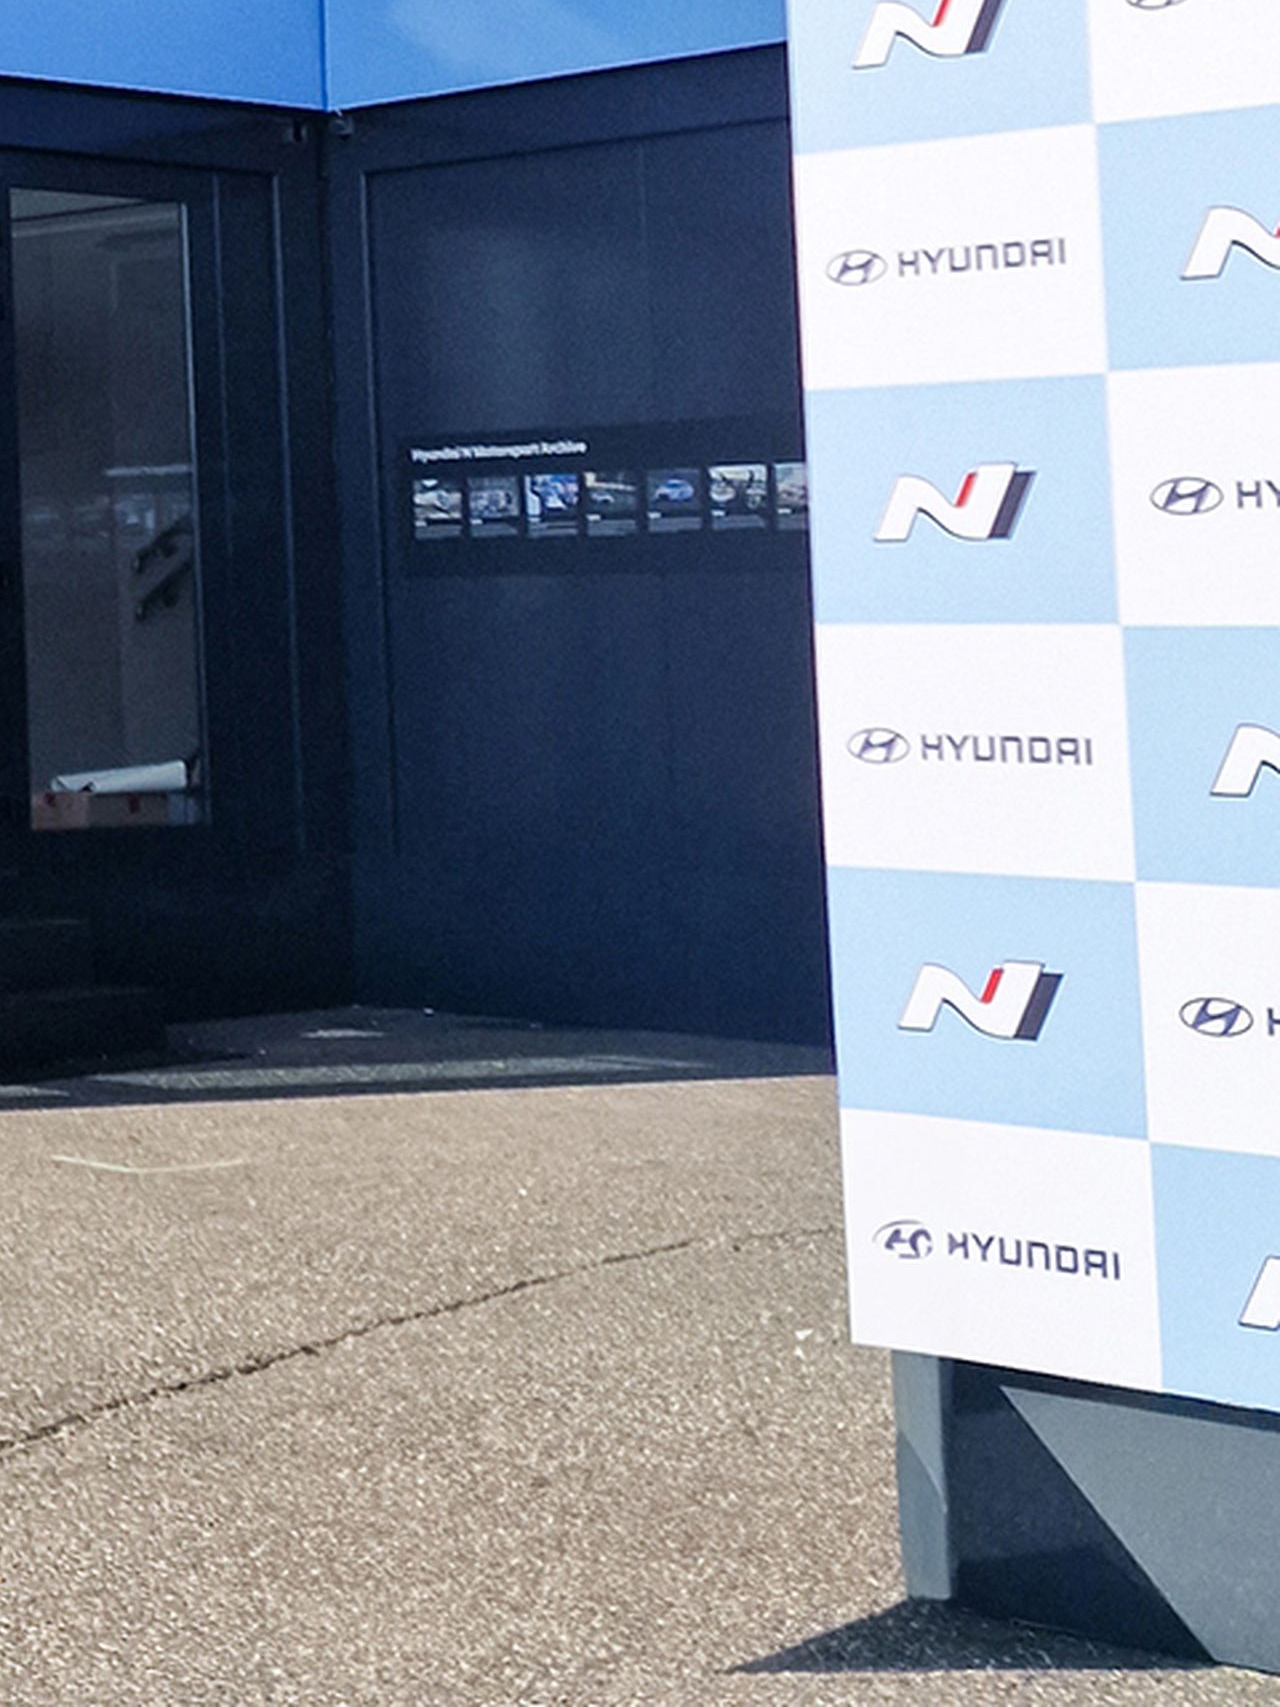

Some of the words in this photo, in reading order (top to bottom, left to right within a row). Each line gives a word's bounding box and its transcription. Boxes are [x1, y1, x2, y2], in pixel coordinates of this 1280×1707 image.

[896, 237, 1067, 278] HYUNDAI
[919, 734, 1093, 766] HYUNDAI
[947, 1231, 1122, 1281] HYUNDAI
